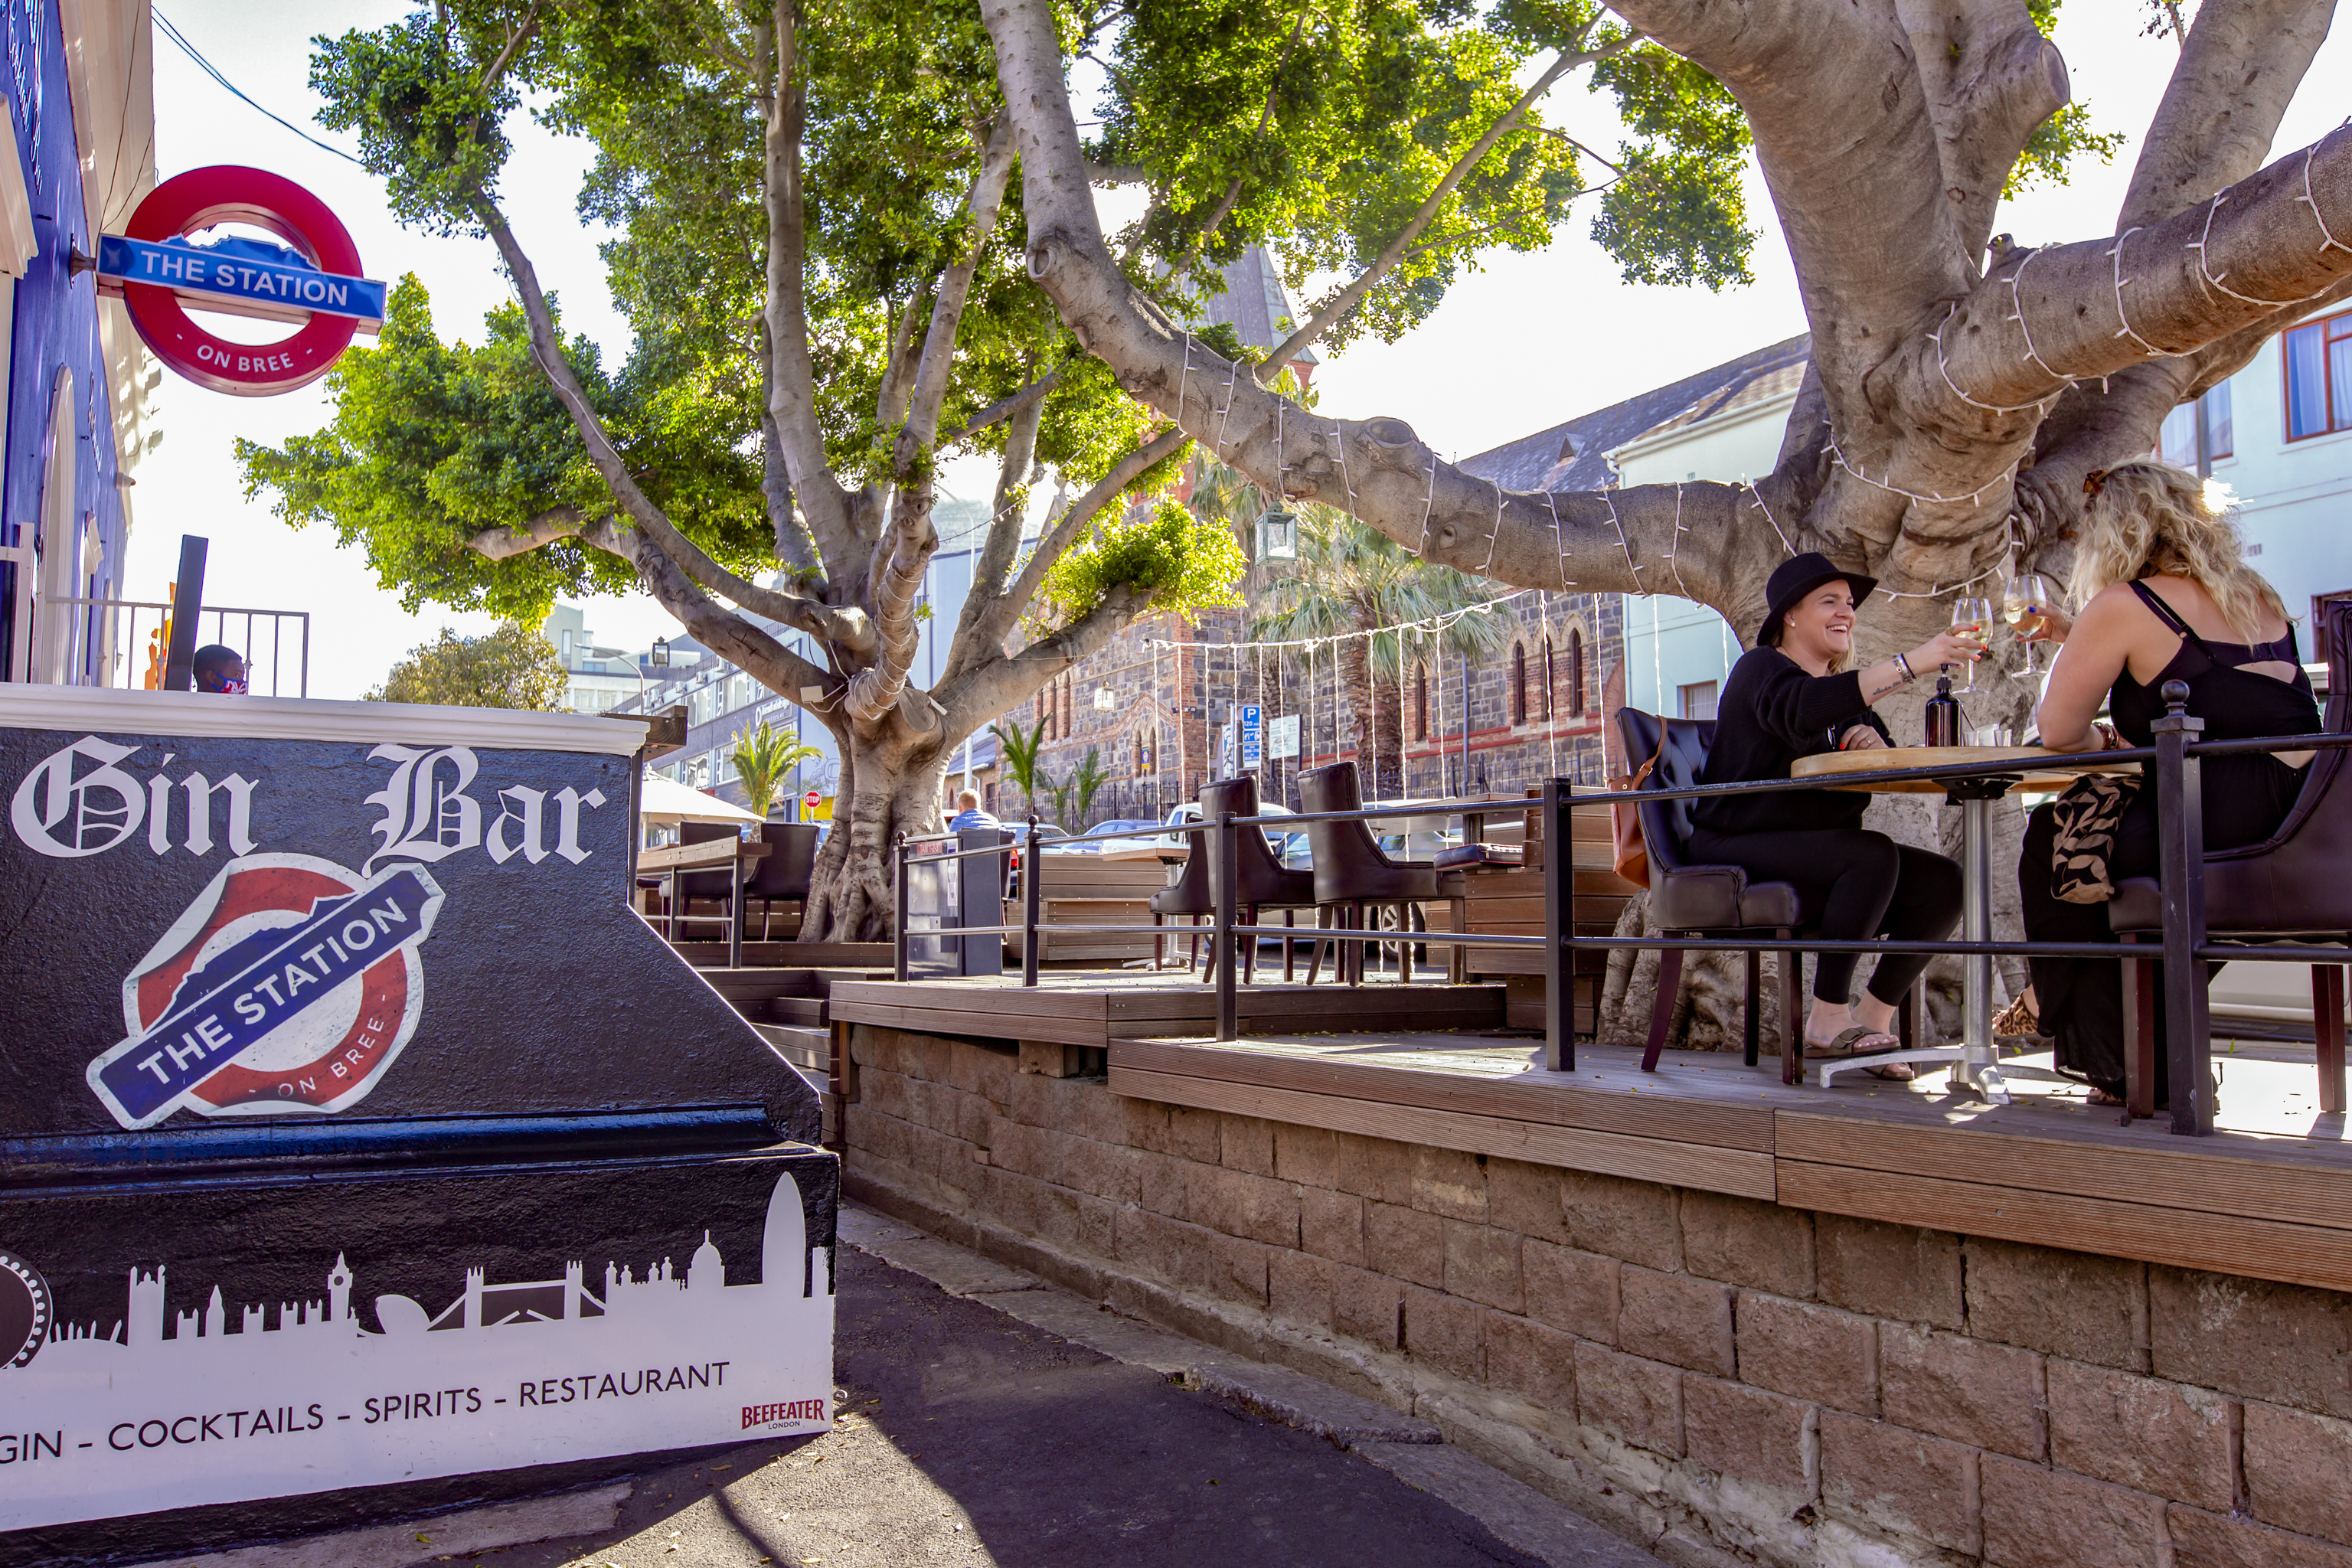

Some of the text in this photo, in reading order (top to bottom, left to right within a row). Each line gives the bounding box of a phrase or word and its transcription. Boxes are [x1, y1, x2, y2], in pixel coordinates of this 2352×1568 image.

[141, 250, 348, 306] THE STATION
[196, 344, 231, 368] ON
[237, 352, 295, 374] BREE
[1247, 708, 1256, 719] P
[11, 735, 608, 879] Gin Bar
[805, 795, 820, 804] STOP
[136, 897, 408, 1084] THE STATION
[277, 1079, 317, 1098] ON
[330, 1017, 385, 1080] BREE
[108, 1403, 324, 1451] COCKTAILS
[364, 1387, 482, 1424] SPIRITS
[519, 1361, 730, 1407] RESTAURANT
[741, 1399, 825, 1430] BEEFEATER
[768, 1420, 800, 1429] LONDON
